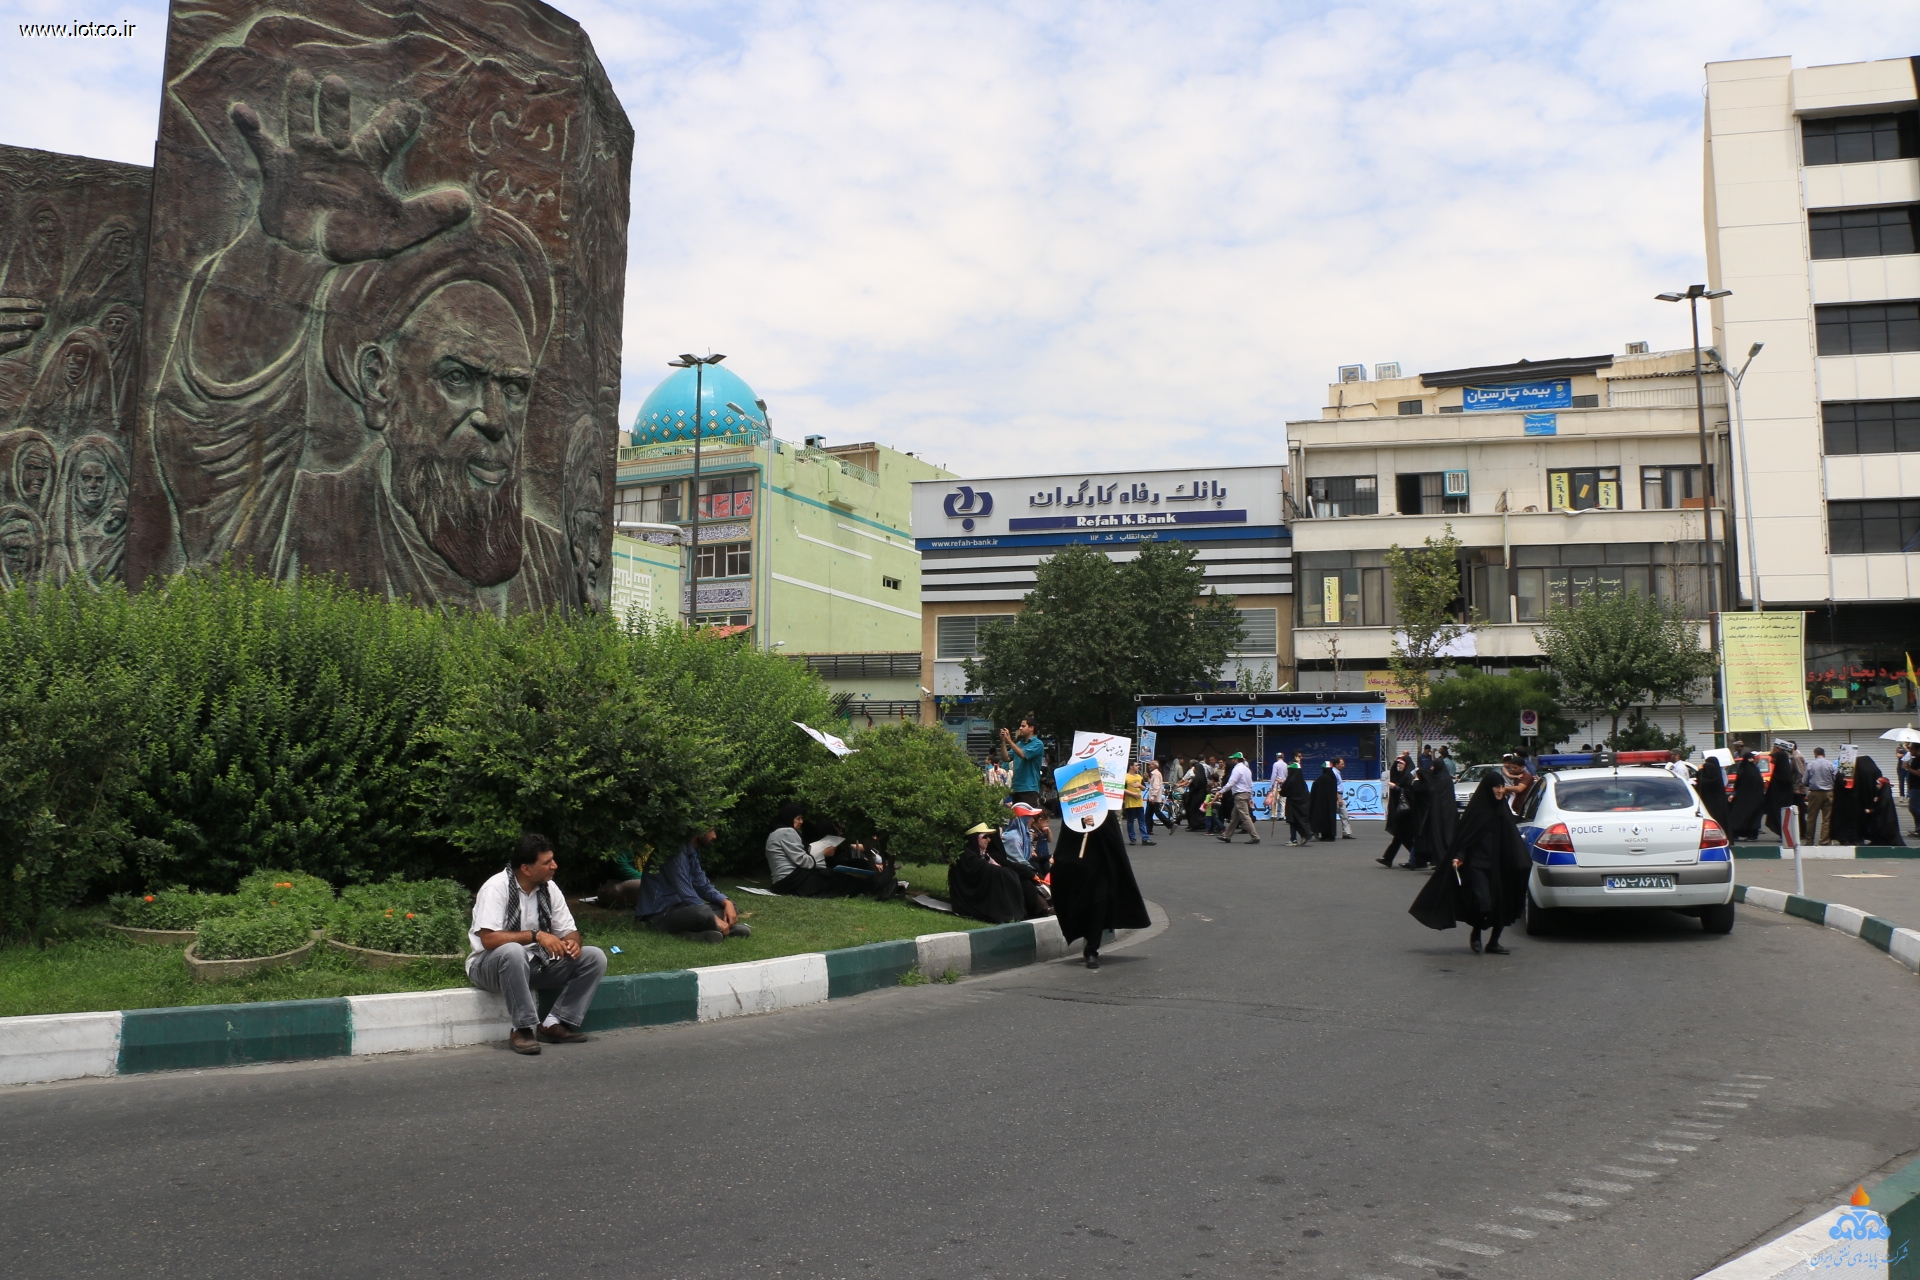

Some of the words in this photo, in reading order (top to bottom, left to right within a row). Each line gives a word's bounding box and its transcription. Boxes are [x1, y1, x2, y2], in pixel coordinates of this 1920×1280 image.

[1467, 388, 1520, 404] پارسیان
[1522, 387, 1551, 398] بیمه
[1030, 478, 1118, 508] کارگران
[1120, 482, 1160, 505] رفاه
[1076, 516, 1118, 527] Refah
[932, 539, 998, 548] www.refah-bank.ir
[1120, 534, 1140, 542] انقلاب
[1574, 577, 1594, 588] آریا
[1806, 664, 1836, 682] فوری
[1174, 708, 1208, 722] ایران
[1210, 707, 1236, 722] نفتی
[1239, 707, 1273, 722] های
[1276, 707, 1301, 722] پایانه
[1303, 706, 1348, 722] شرکت
[1075, 736, 1114, 756] قدس
[1070, 800, 1098, 814] Palestine
[1571, 826, 1603, 834] POLICE
[1614, 878, 1627, 887] ۵۵
[1639, 877, 1657, 887] ۸۶۷
